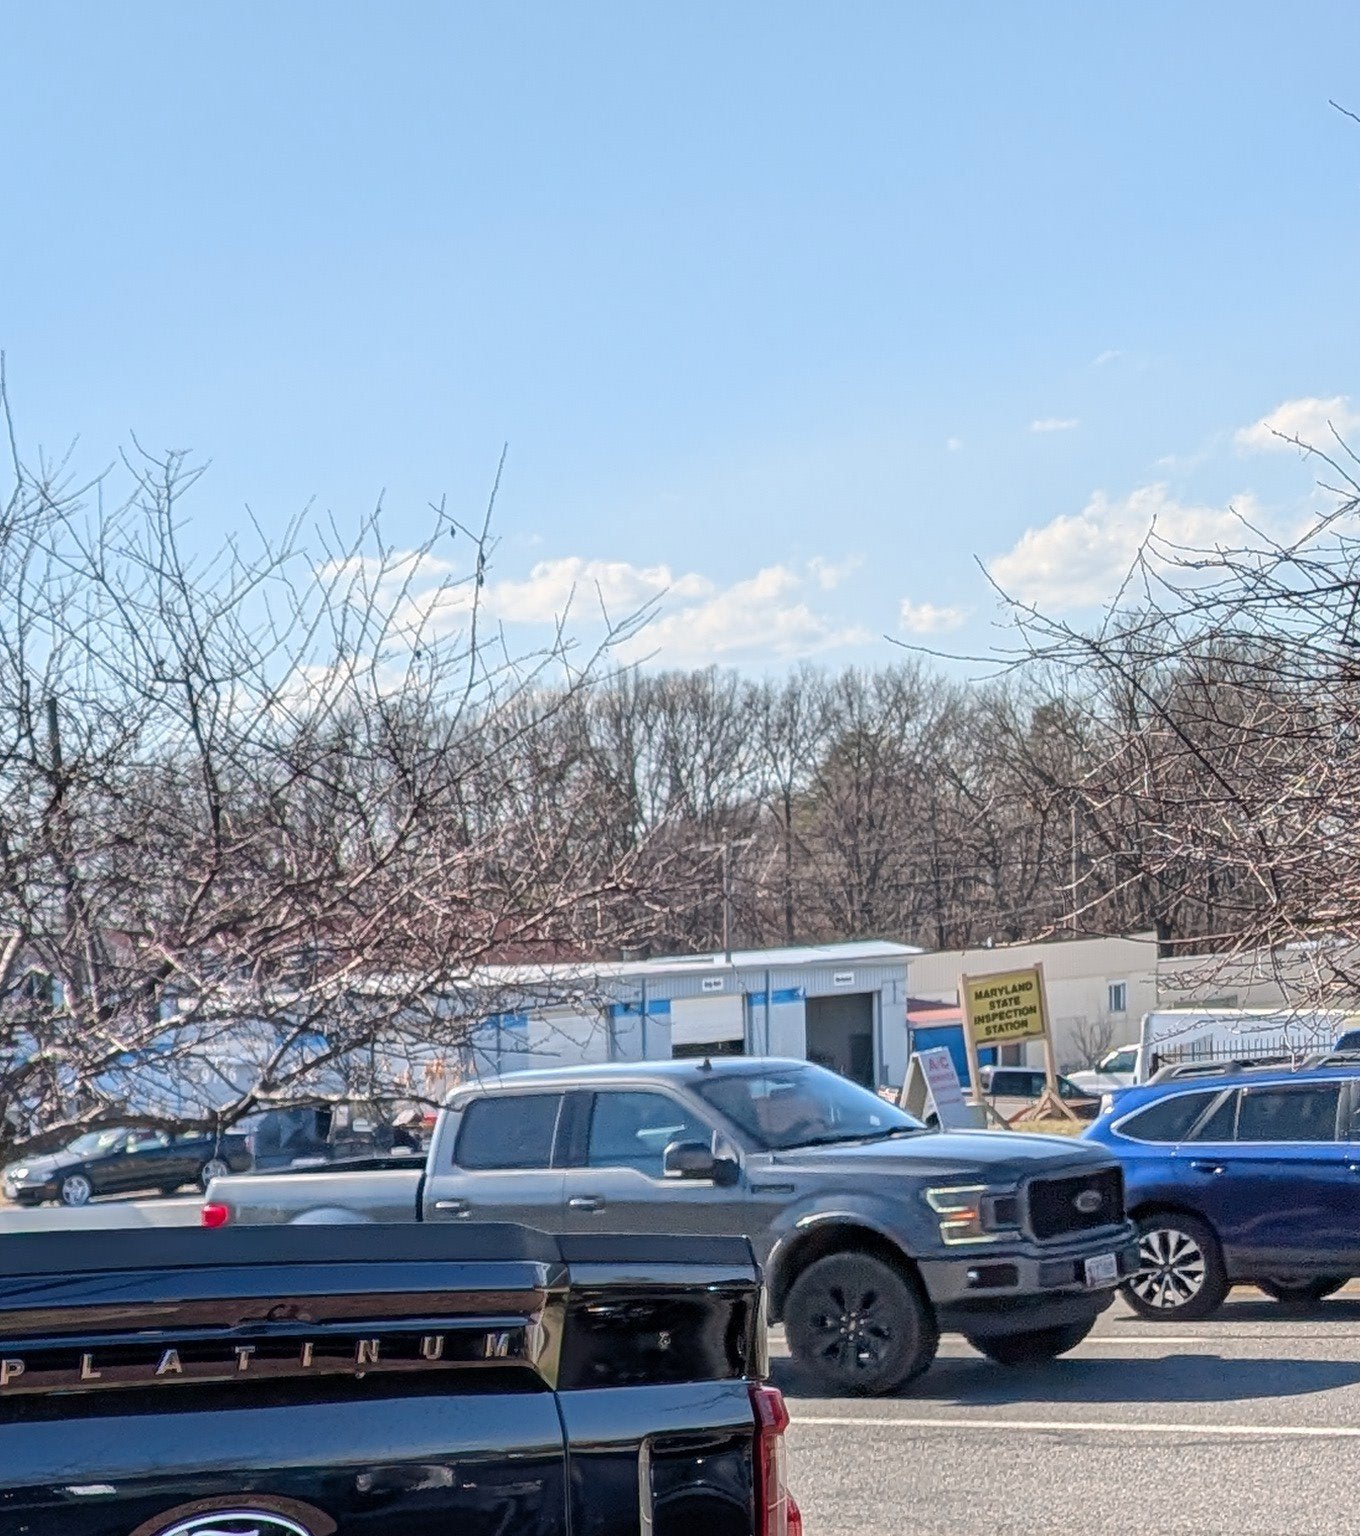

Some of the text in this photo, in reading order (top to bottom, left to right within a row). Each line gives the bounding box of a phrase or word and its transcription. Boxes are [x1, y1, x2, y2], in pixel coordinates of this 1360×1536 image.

[974, 981, 1033, 1001] MARYLAND
[989, 996, 1021, 1011] STATE
[974, 1005, 1037, 1025] INSPECTION
[984, 1019, 1029, 1036] STATION
